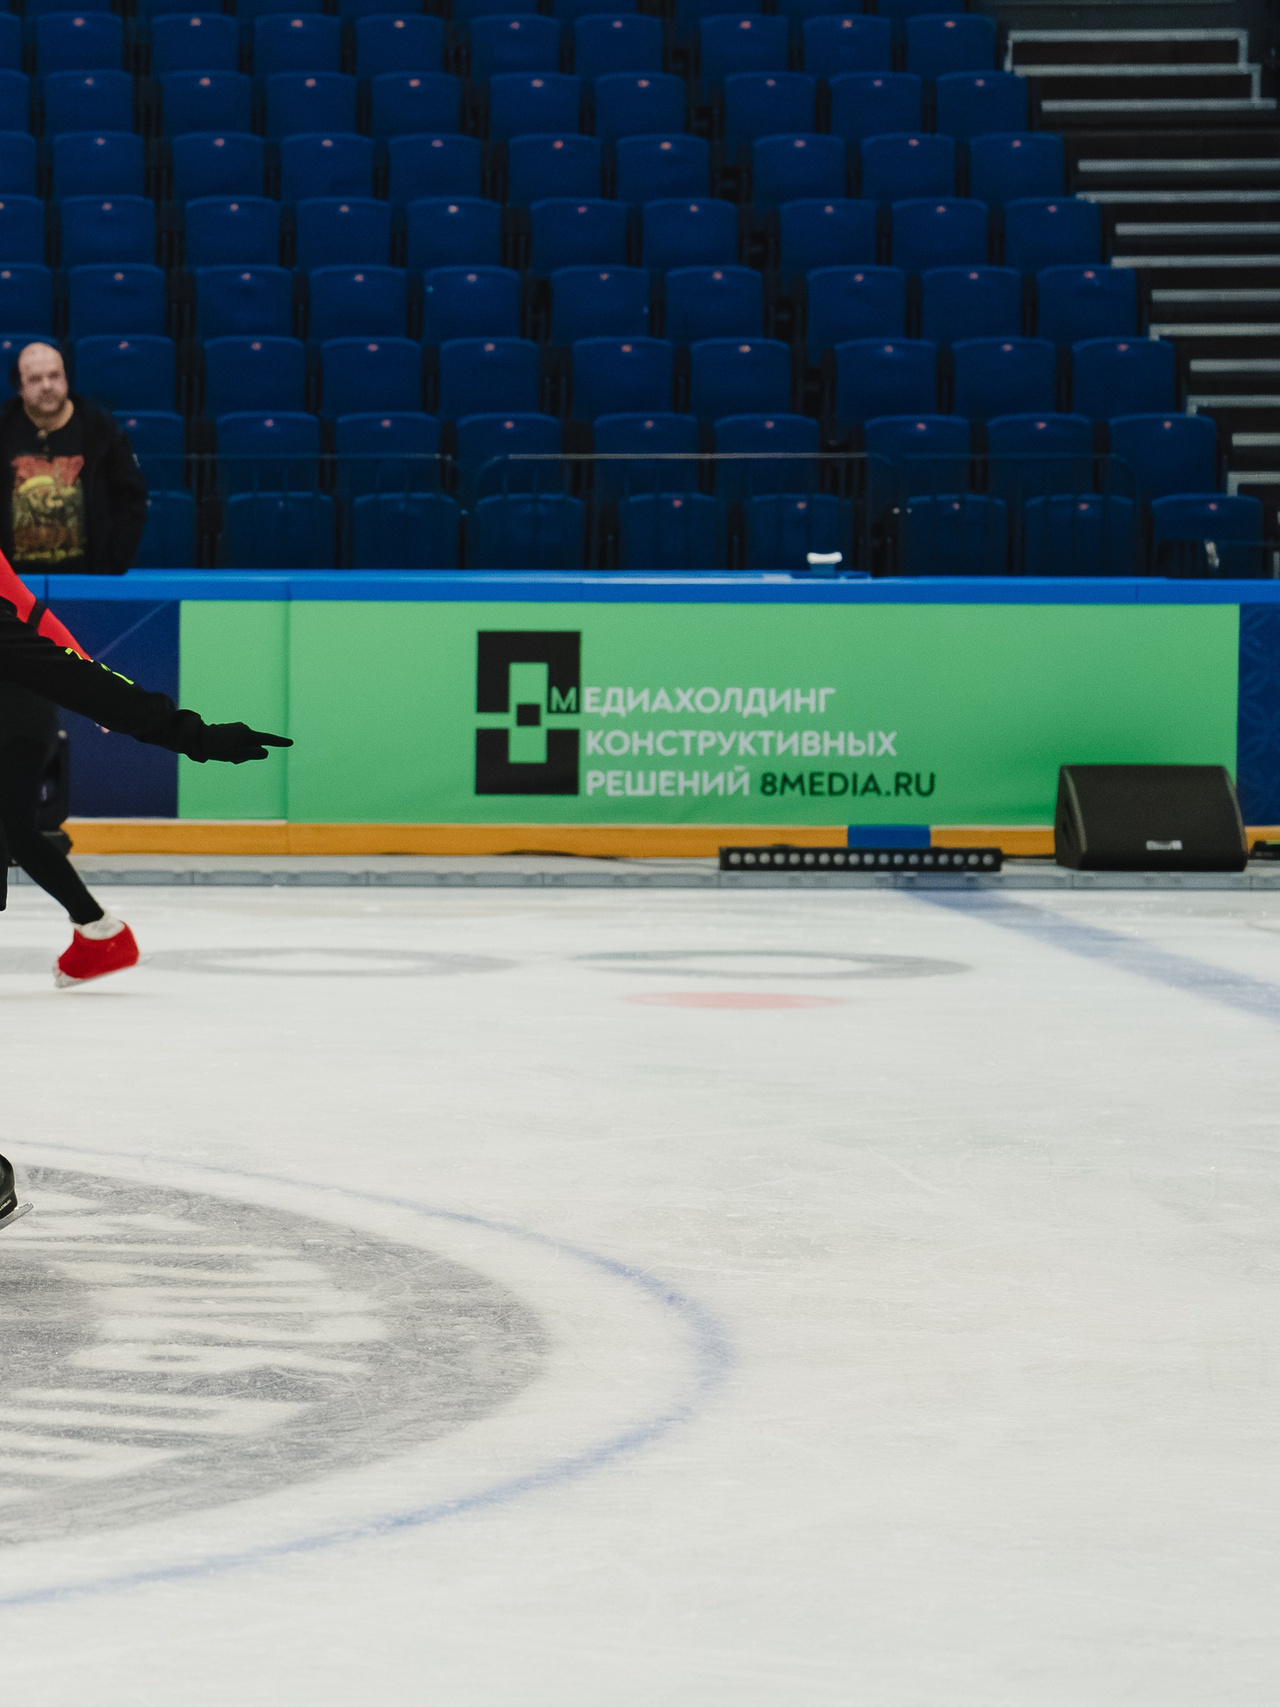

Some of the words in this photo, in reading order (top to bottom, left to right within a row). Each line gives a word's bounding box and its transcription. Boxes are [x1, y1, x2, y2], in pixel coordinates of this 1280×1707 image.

[551, 686, 836, 718] МЕДИАХОЛДИНГ
[586, 730, 898, 757] КОНСТРУКТИВНЫХ
[586, 765, 750, 796] РЕШЕНИЙ
[760, 771, 936, 797] 8MEDIA.RU
